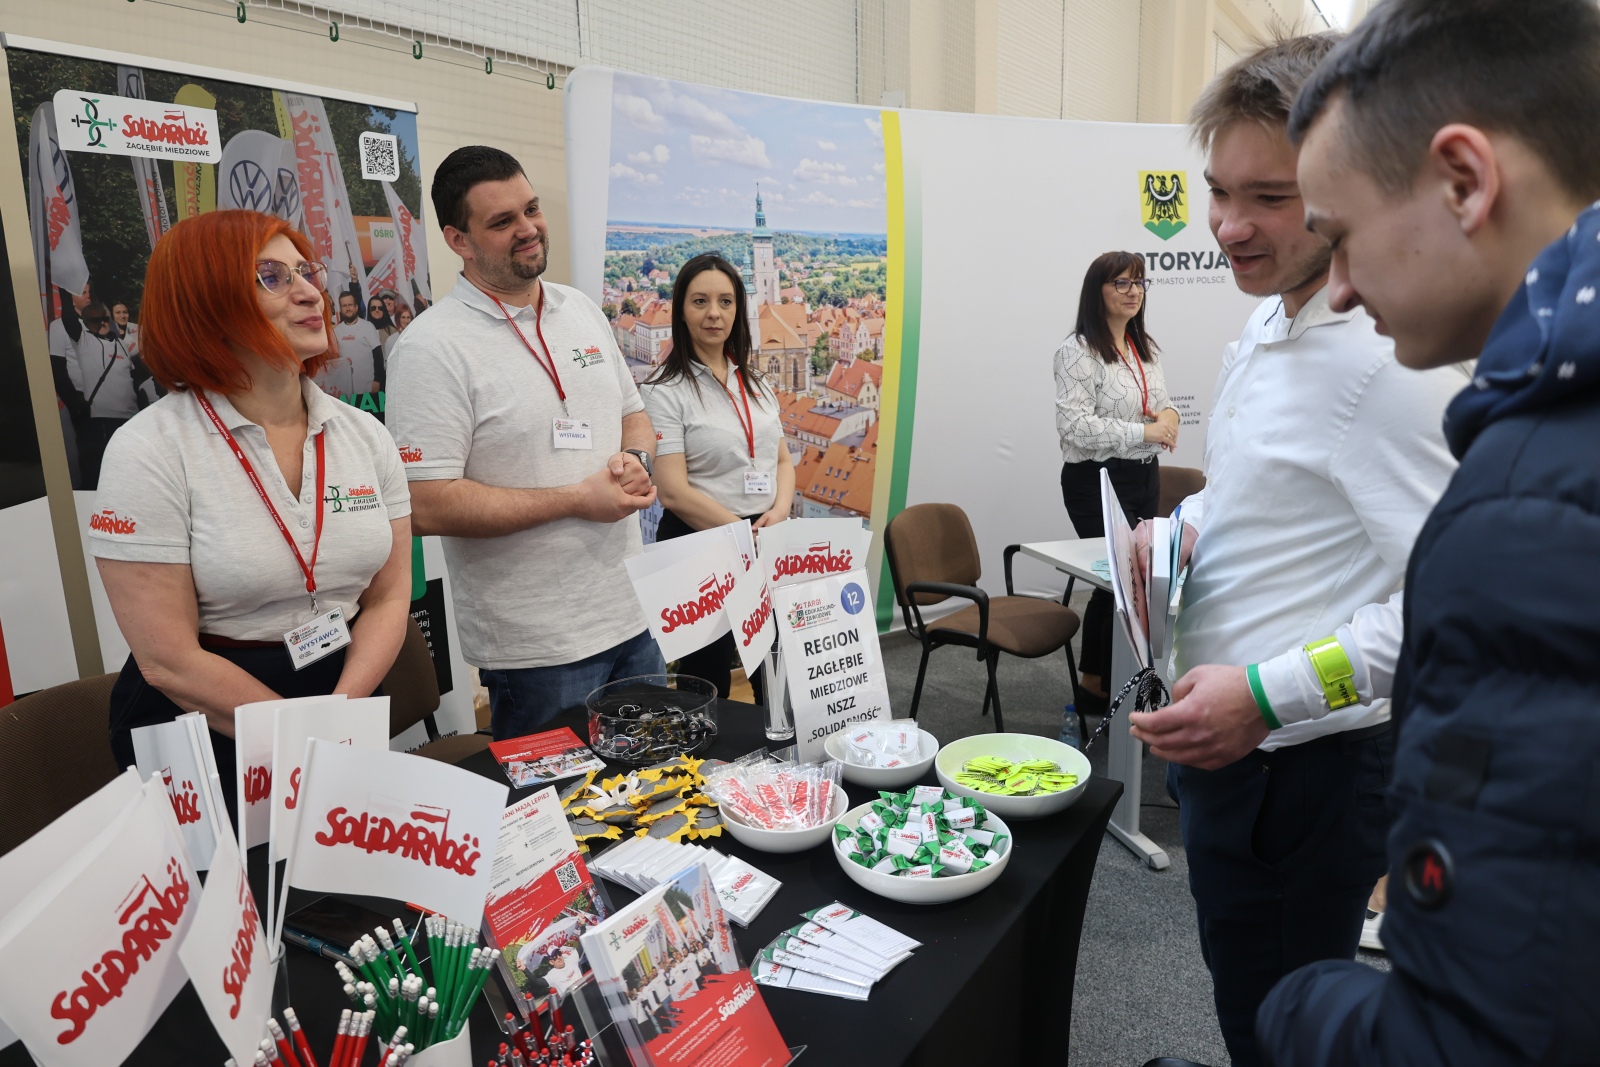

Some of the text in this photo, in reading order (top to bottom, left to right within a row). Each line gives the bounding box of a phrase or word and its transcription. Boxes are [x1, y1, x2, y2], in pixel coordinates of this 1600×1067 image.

[126, 142, 210, 157] ZAGŁĘBIE MIEDZIOWE
[373, 228, 395, 238] OŚRO
[1141, 251, 1229, 271] TORYJA
[1156, 277, 1184, 285] MIASTO
[1186, 276, 1194, 284] W
[1196, 275, 1226, 284] POLSCE
[558, 431, 586, 439] WYSTAWCA
[803, 591, 860, 609] TARGI 12
[298, 627, 339, 652] WYSTAWCA
[803, 628, 859, 657] REGION
[807, 653, 864, 681] ZAGŁĘBIE
[810, 672, 869, 700] MIEDZIOWE
[827, 696, 857, 716] NSZZ
